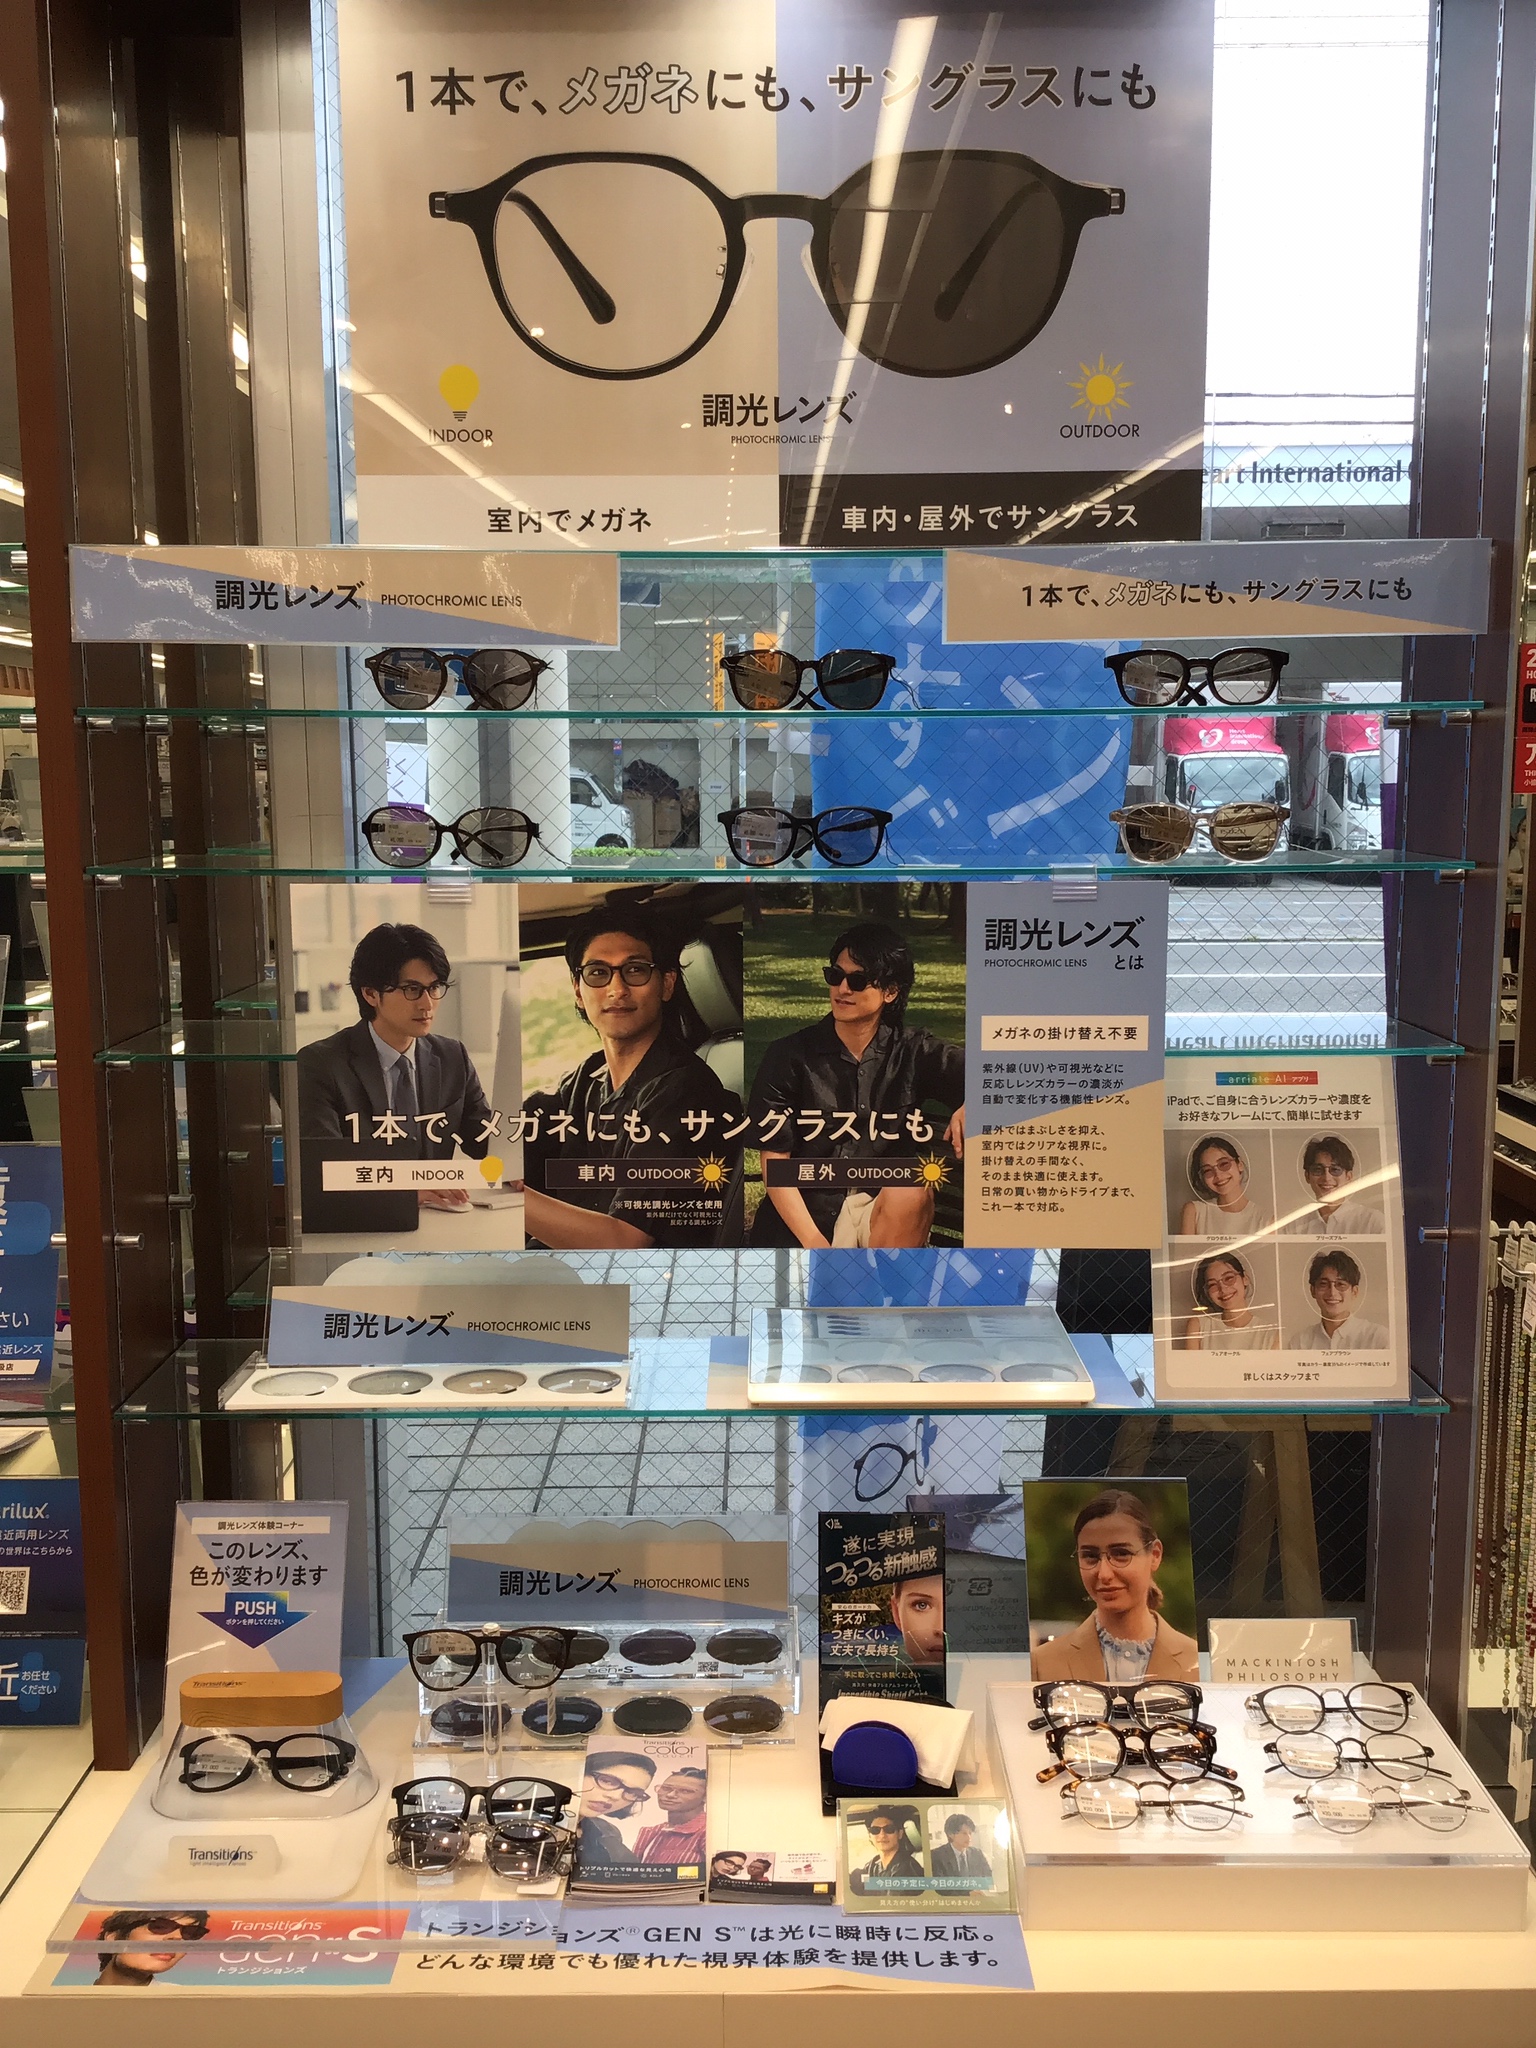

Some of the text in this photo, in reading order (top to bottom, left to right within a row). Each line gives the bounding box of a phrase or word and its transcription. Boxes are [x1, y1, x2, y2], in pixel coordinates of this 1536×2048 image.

[395, 63, 1157, 116] 1本で、メガネにも、サングラスにも
[702, 391, 857, 428] 調光レンズ
[428, 429, 494, 443] INDOOR
[1060, 424, 1140, 438] OUTDOOR
[731, 435, 806, 444] PHOTOCHROMIC
[1252, 460, 1402, 484] International
[487, 506, 652, 533] 室内でメガネ
[841, 503, 1138, 532] 車内・屋外でサングラス
[214, 579, 364, 610] 調光レンズ
[1021, 577, 1413, 608] 1本で、メガネにも、サングラスにも
[381, 594, 522, 607] PHOTOCHROMIC LENS
[985, 916, 1145, 951] 調光レンズ
[984, 958, 1088, 967] PHOTOCHROMIC LENS
[1114, 955, 1144, 970] とは
[992, 1026, 1138, 1040] メガネの掛け替え不要
[982, 1078, 1124, 1089] 反応しレンズカラーの濃淡が
[1228, 1076, 1270, 1084] arriate
[982, 1094, 1130, 1105] 自動で変化する機能性レンズ。
[1167, 1094, 1372, 1107] iPadで、ご自身に合うレンズカラーや濃度を
[1178, 1109, 1363, 1122] お好きなフレームにて、簡単に試せます
[344, 1107, 934, 1146] 1本で、メガネにも、サングラスにも
[981, 1125, 1106, 1136] 屋外ではまぶしさを抑え、
[981, 1140, 1107, 1151] 室内ではクリアな視界に。
[981, 1156, 1084, 1166] 掛け替えの手間なく、
[355, 1166, 464, 1184] 室内 INDOOR
[577, 1164, 691, 1183] 車内 OUTDOOR
[798, 1163, 912, 1181] 屋外 OUTDOOR
[981, 1171, 1103, 1182] そのまま快適に使えます。
[981, 1186, 1135, 1197] 日常の買い物からドライブまで、
[981, 1202, 1065, 1213] これ一本で対応。
[324, 1311, 455, 1340] 調光レンズ
[467, 1321, 591, 1332] PHOTOCHROMIC LENS
[1243, 1372, 1320, 1382] 詳しくはスタッフまで
[217, 1521, 304, 1530] 調光レンズ体験コーナー
[843, 1526, 915, 1557] 遂に実現
[208, 1539, 309, 1560] このレンズ、
[825, 1546, 937, 1586] つるつる新触感
[190, 1565, 328, 1586] 色が変わります
[499, 1568, 621, 1597] 調光レンズ
[633, 1578, 750, 1589] PHOTOCHROMIC LENS
[234, 1601, 277, 1615] PUSH
[225, 1618, 285, 1626] ボタンを押してください
[831, 1613, 866, 1624] キズが
[831, 1629, 889, 1640] つきにくい、
[829, 1644, 899, 1656] 丈夫で長持ち
[1226, 1658, 1340, 1668] MACKINTOSH
[21, 1670, 50, 1681] お任せ
[1226, 1673, 1340, 1682] PHILOSOPHY
[20, 1685, 57, 1695] ください
[193, 1681, 246, 1689] Transitions
[643, 1741, 700, 1755] color
[188, 1846, 254, 1864] Transitions
[876, 1878, 982, 1888] 今日の予定に、今日のメガネ。
[230, 1919, 325, 1932] Transitions
[415, 1947, 1000, 1971] どんな環境でも優れた視界体験を提供します。
[217, 1966, 308, 1975] トランジションズ
